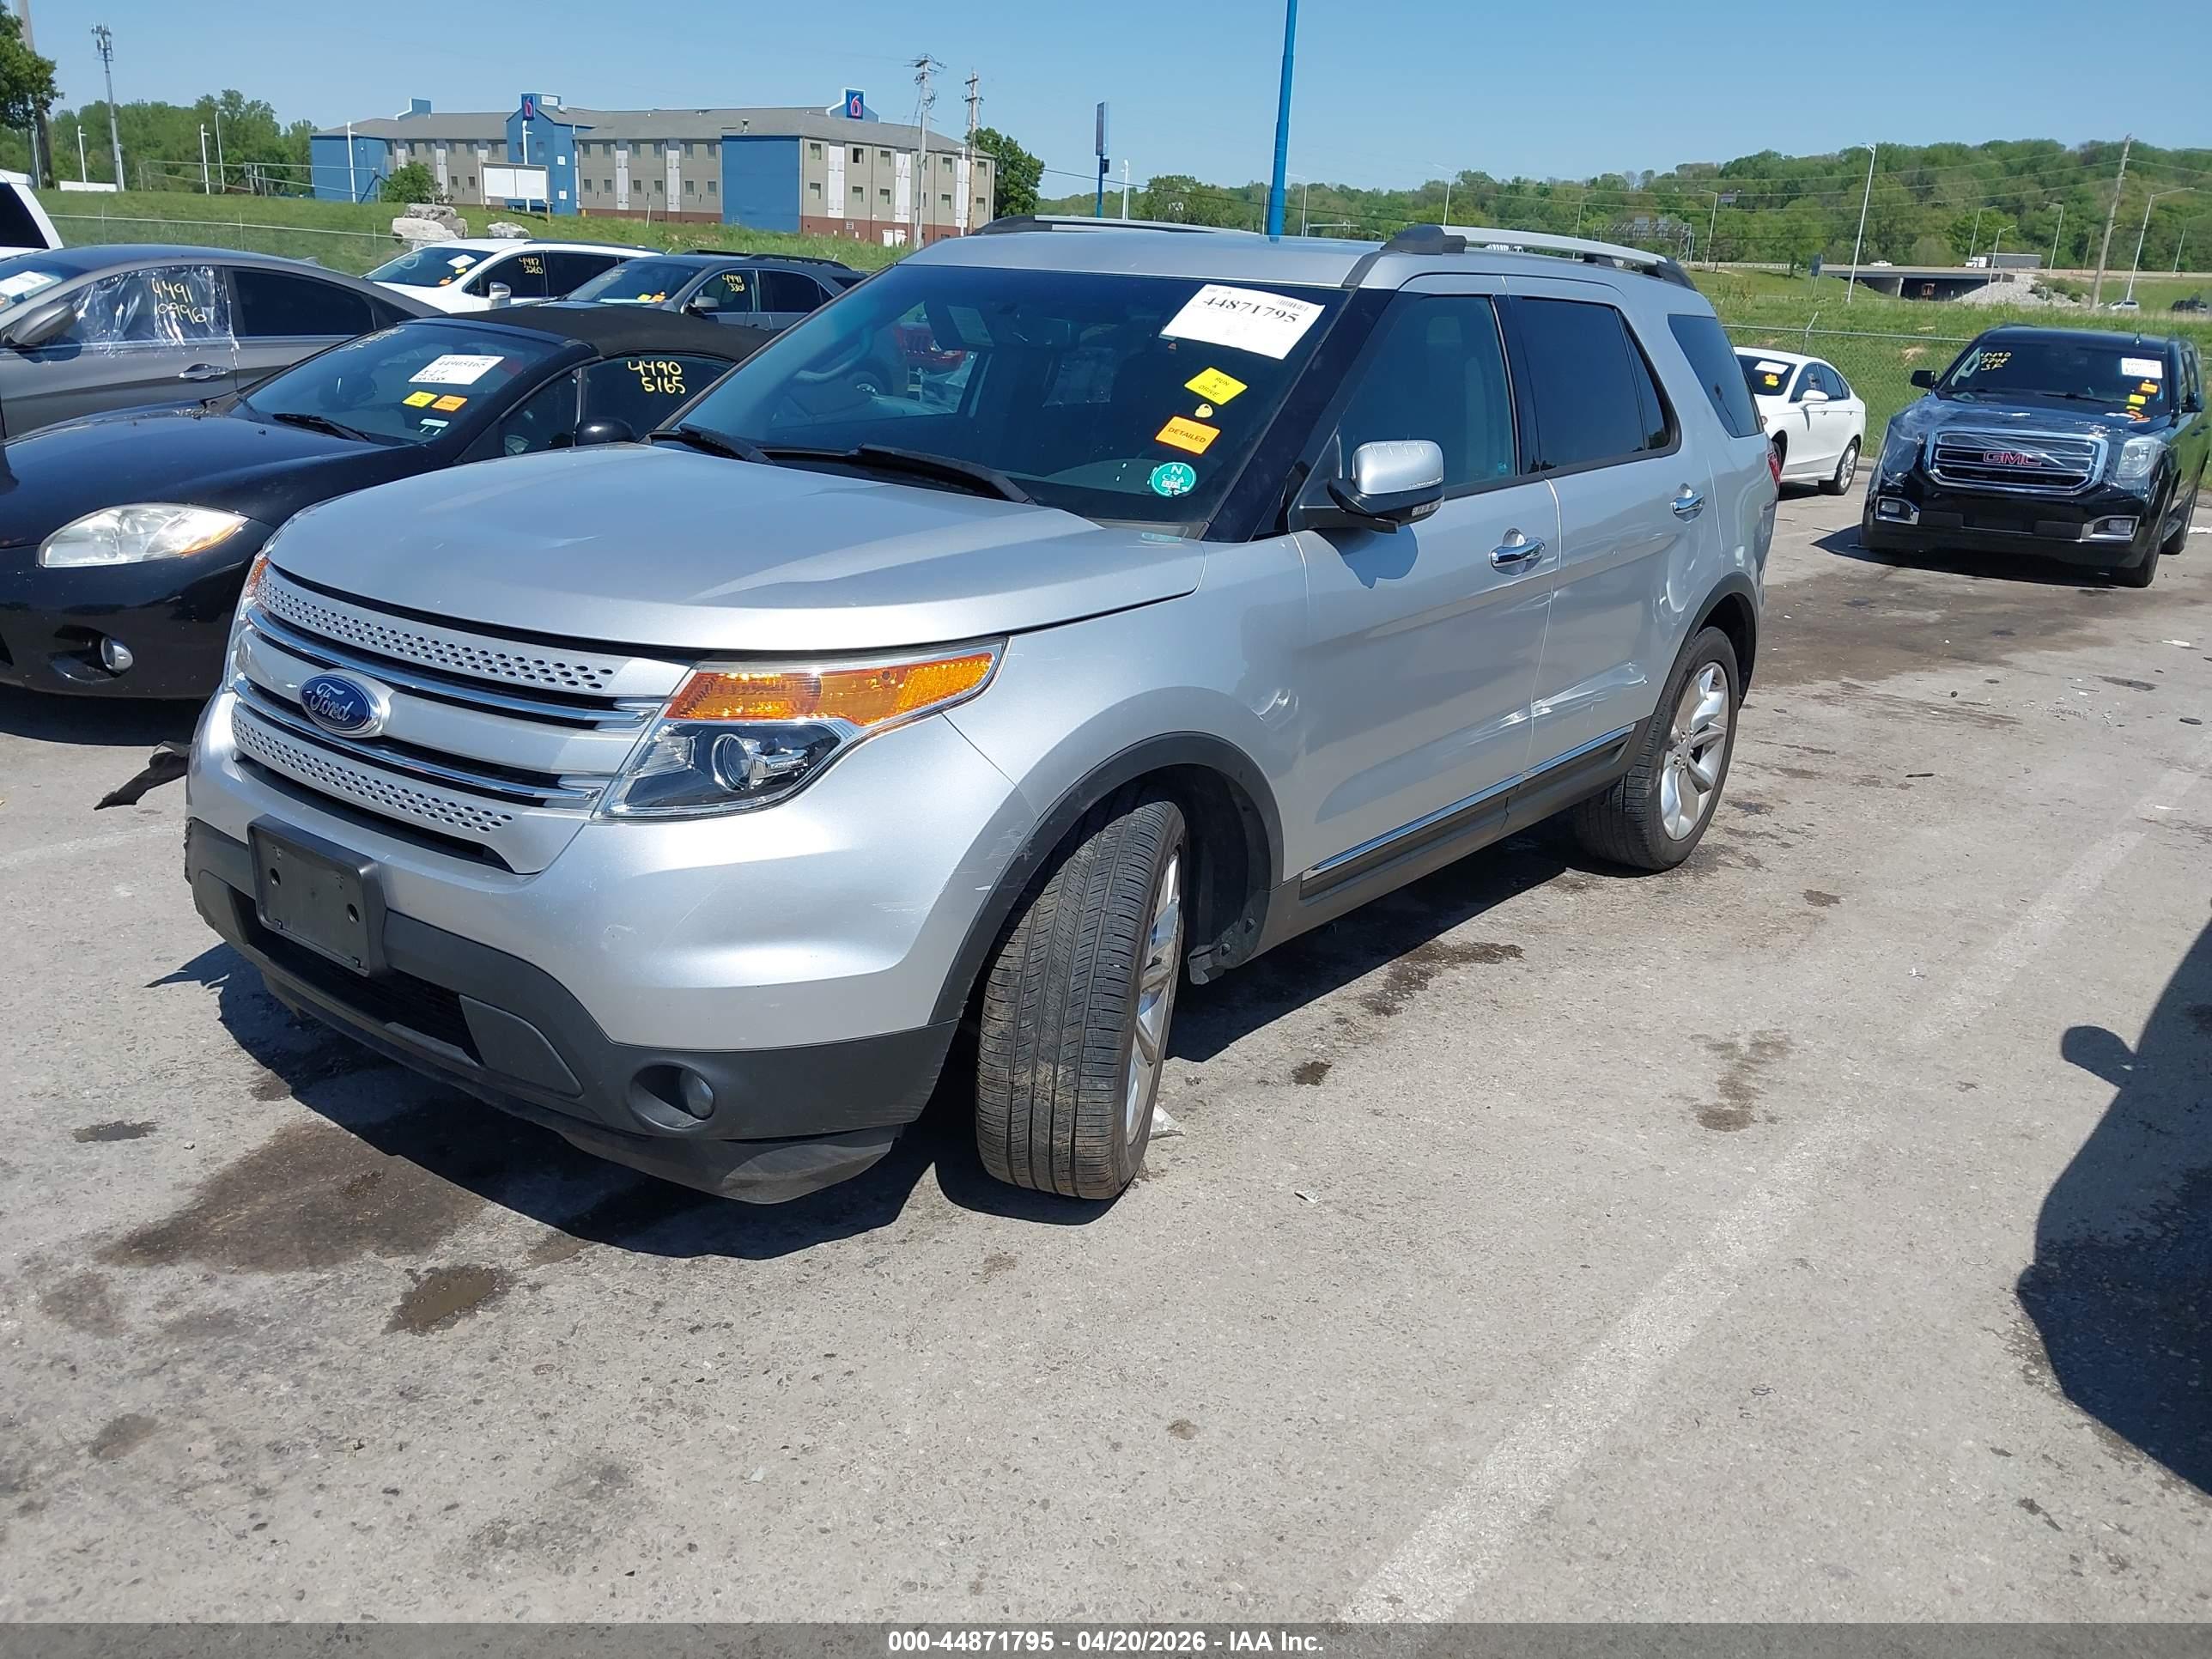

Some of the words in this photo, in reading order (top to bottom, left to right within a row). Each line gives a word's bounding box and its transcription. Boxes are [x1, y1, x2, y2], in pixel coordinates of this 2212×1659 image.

[850, 94, 862, 118] 6
[151, 276, 194, 304] 4491
[157, 302, 208, 325] 0996
[1202, 296, 1300, 324] 44871795
[627, 360, 683, 377] 4490
[641, 375, 686, 395] 5165
[1215, 376, 1231, 386] RUN
[1198, 384, 1220, 398] DRIVE
[1168, 427, 1206, 443] DETAILED
[1983, 450, 2042, 466] GMC
[1170, 465, 1184, 475] N
[309, 682, 355, 722] Ford
